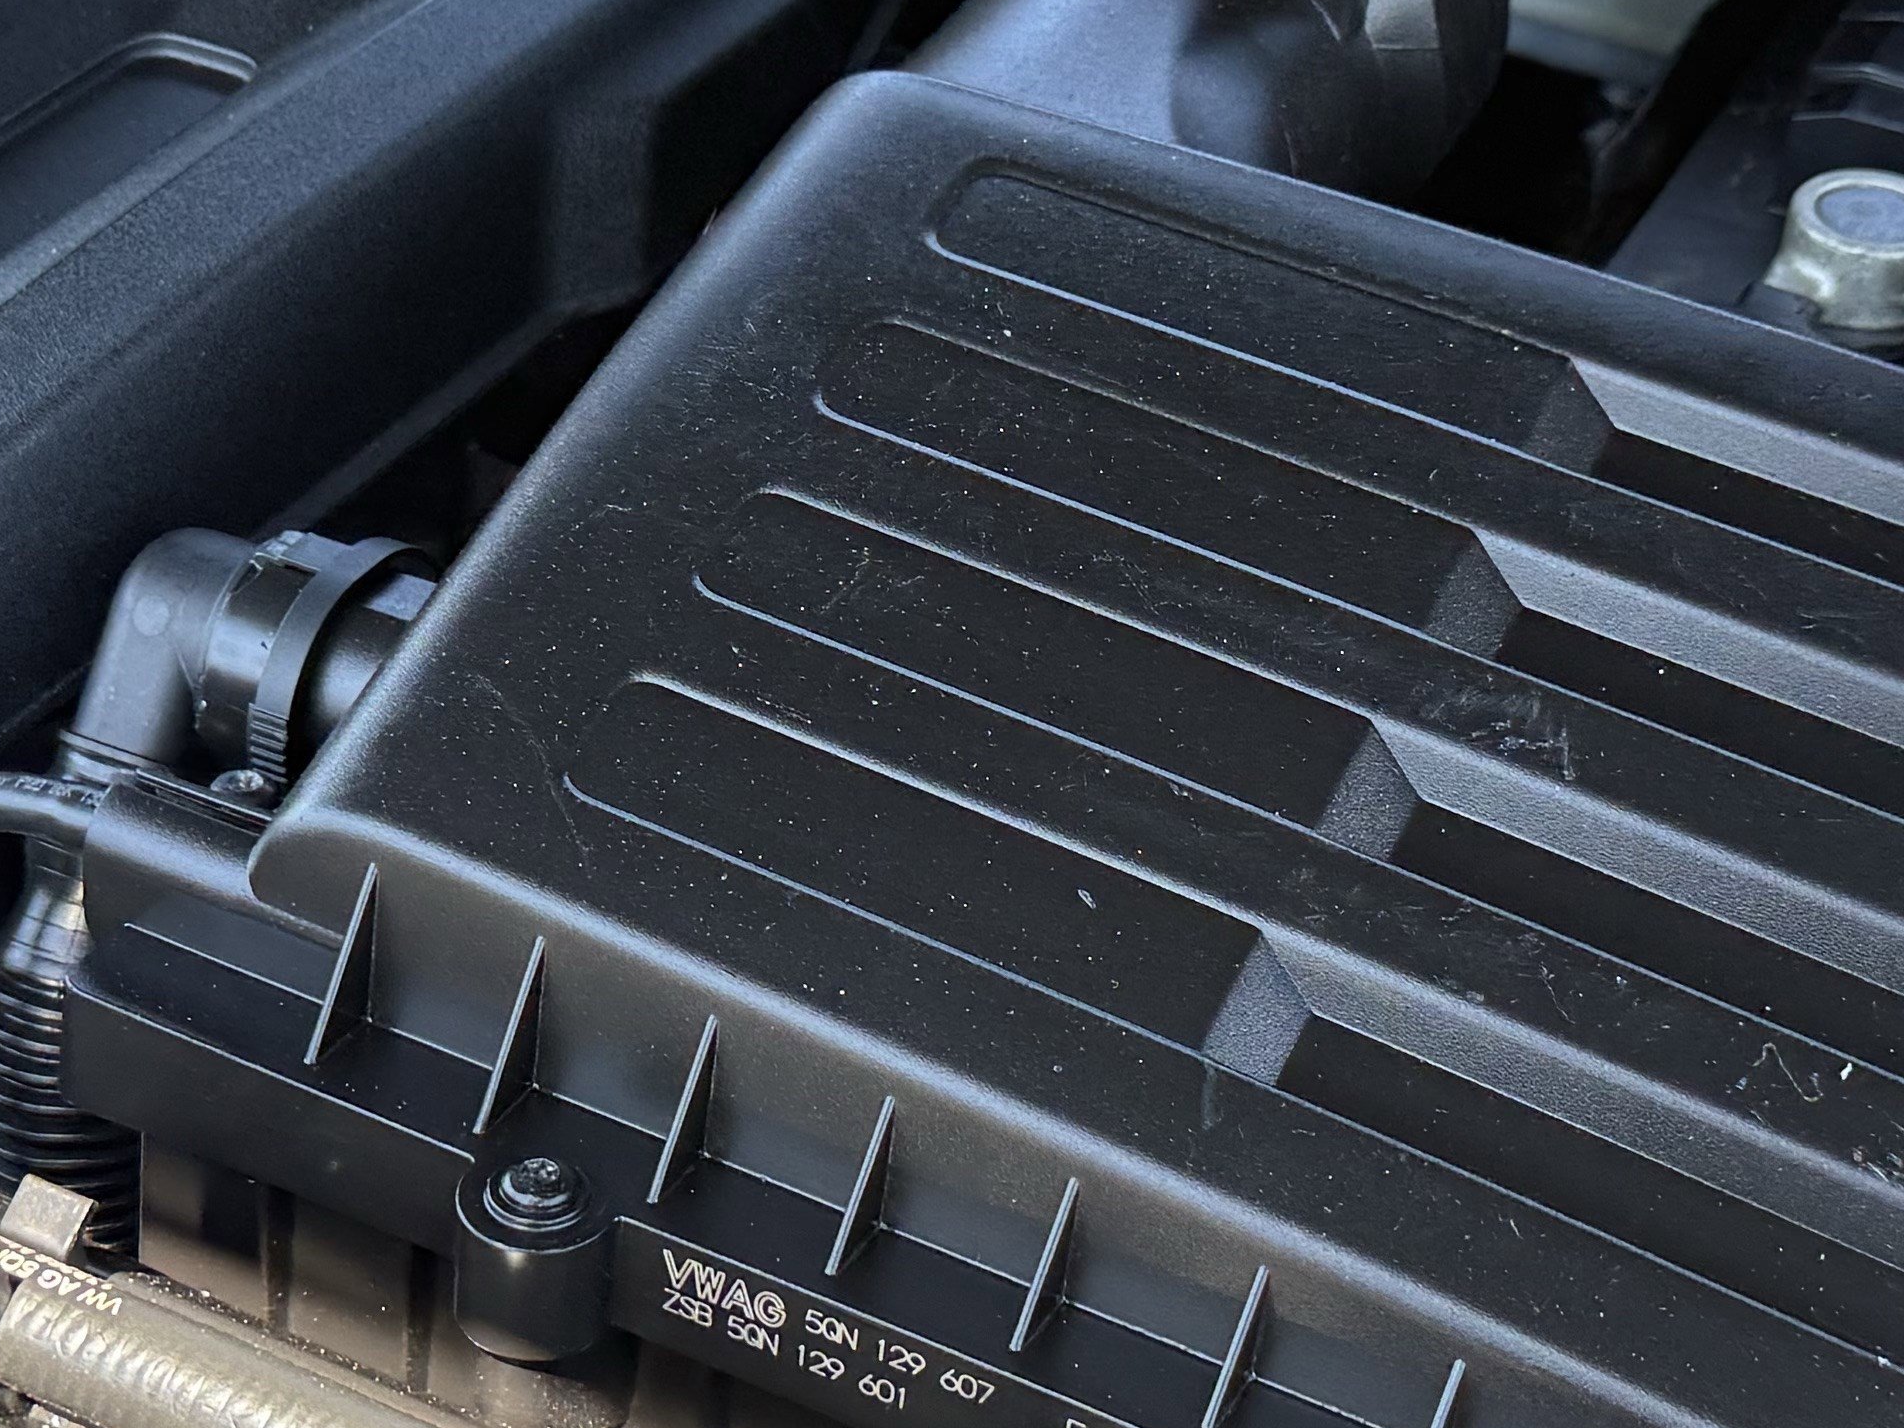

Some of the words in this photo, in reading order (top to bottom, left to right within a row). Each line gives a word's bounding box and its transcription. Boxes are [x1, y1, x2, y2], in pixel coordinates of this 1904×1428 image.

[38, 1267, 85, 1299] AG
[77, 1284, 124, 1317] VW
[661, 1287, 713, 1328] ZSB
[726, 1316, 780, 1357] 5QN
[797, 1344, 845, 1381] 129
[858, 1373, 907, 1410] 601
[803, 1308, 860, 1352] 5QN
[876, 1338, 927, 1376] 129
[939, 1368, 996, 1405] 607
